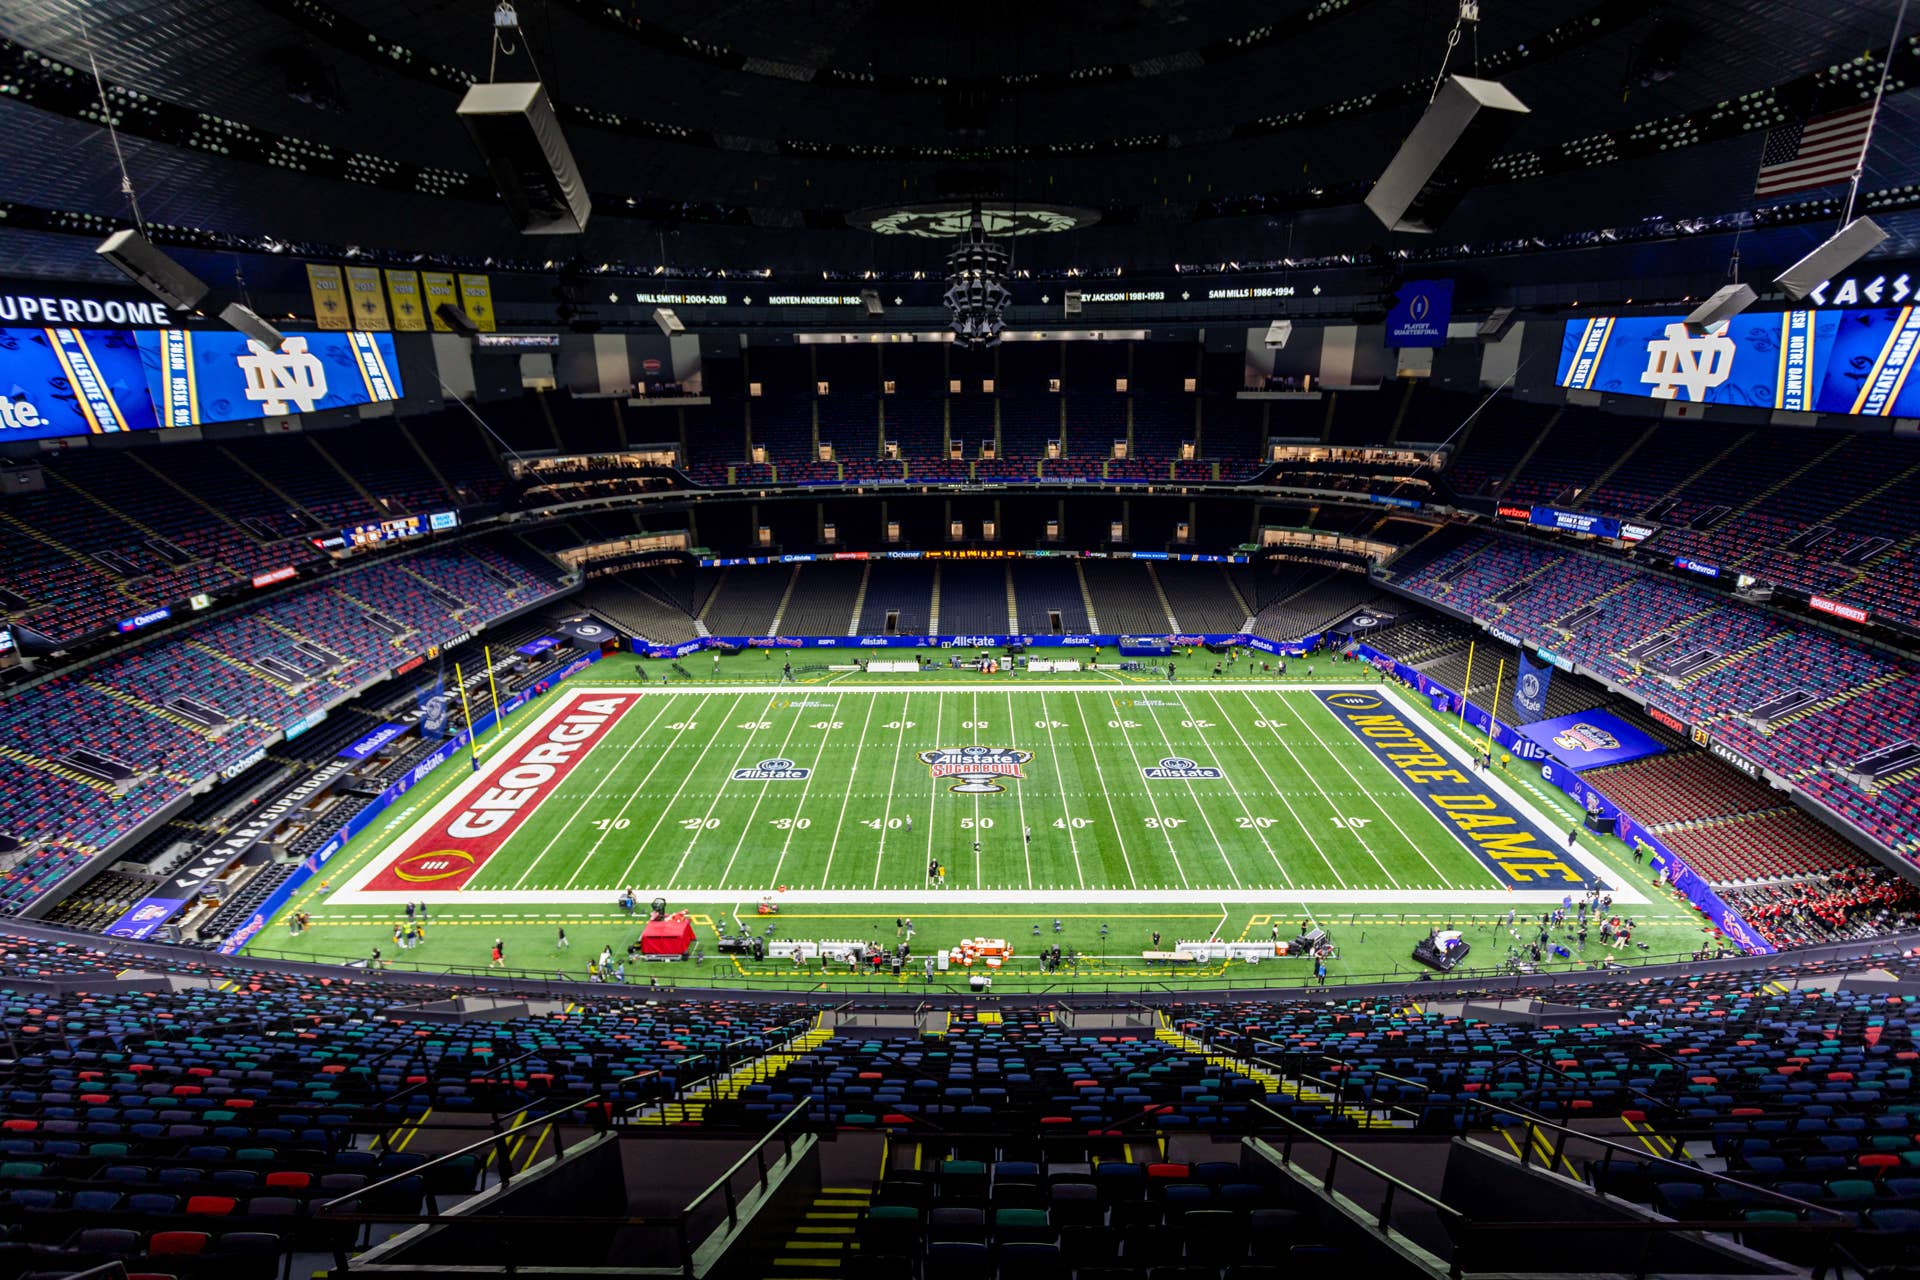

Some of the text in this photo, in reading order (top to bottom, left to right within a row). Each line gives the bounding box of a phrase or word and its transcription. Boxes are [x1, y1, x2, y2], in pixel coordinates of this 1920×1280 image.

[636, 293, 728, 304] WILL SMITH 2004-2013
[1092, 292, 1125, 302] JACKSON
[1129, 291, 1165, 301] 1981-1993
[1208, 287, 1295, 299] SAM MILLS 1986-1994
[769, 296, 800, 305] MORTEN
[801, 296, 839, 305] ANDERSEN
[1788, 336, 1805, 366] NOTRE
[1886, 330, 1919, 366] SUGAR
[169, 342, 186, 370] NOTRE
[66, 351, 99, 401] ALLSTATE
[1786, 368, 1803, 397] DAME
[1499, 507, 1530, 518] verizon
[1687, 560, 1716, 576] Chevron
[134, 609, 168, 627] Chevron
[860, 638, 888, 646] Allstate
[951, 636, 996, 647] Allstate
[1062, 637, 1090, 645] Allstate
[1492, 628, 1521, 647] Ochsner
[676, 643, 699, 655] Allstate
[1250, 639, 1273, 651] Allstate
[1650, 707, 1683, 732] verizon
[354, 728, 397, 754] Allstate
[227, 747, 267, 778] Ochsner
[935, 755, 1013, 764] Allstate
[1714, 745, 1755, 776] CAESARS
[414, 752, 445, 782] Allstate
[446, 697, 627, 839] GEORGIA
[932, 763, 1025, 777] SUGAR BOWL
[1147, 768, 1215, 778] Allstate
[734, 769, 802, 779] Allstate
[1347, 714, 1583, 882] NOTRE DAME
[175, 760, 349, 888] CAESARS SUPERDOME
[597, 818, 631, 830] 10
[683, 818, 721, 830] 20
[776, 818, 811, 830] 30
[868, 818, 903, 830] 40
[960, 818, 994, 829] 50
[1052, 818, 1087, 829] 40
[1144, 817, 1179, 829] 30
[1235, 817, 1272, 829] 20
[1330, 817, 1366, 829] 10
